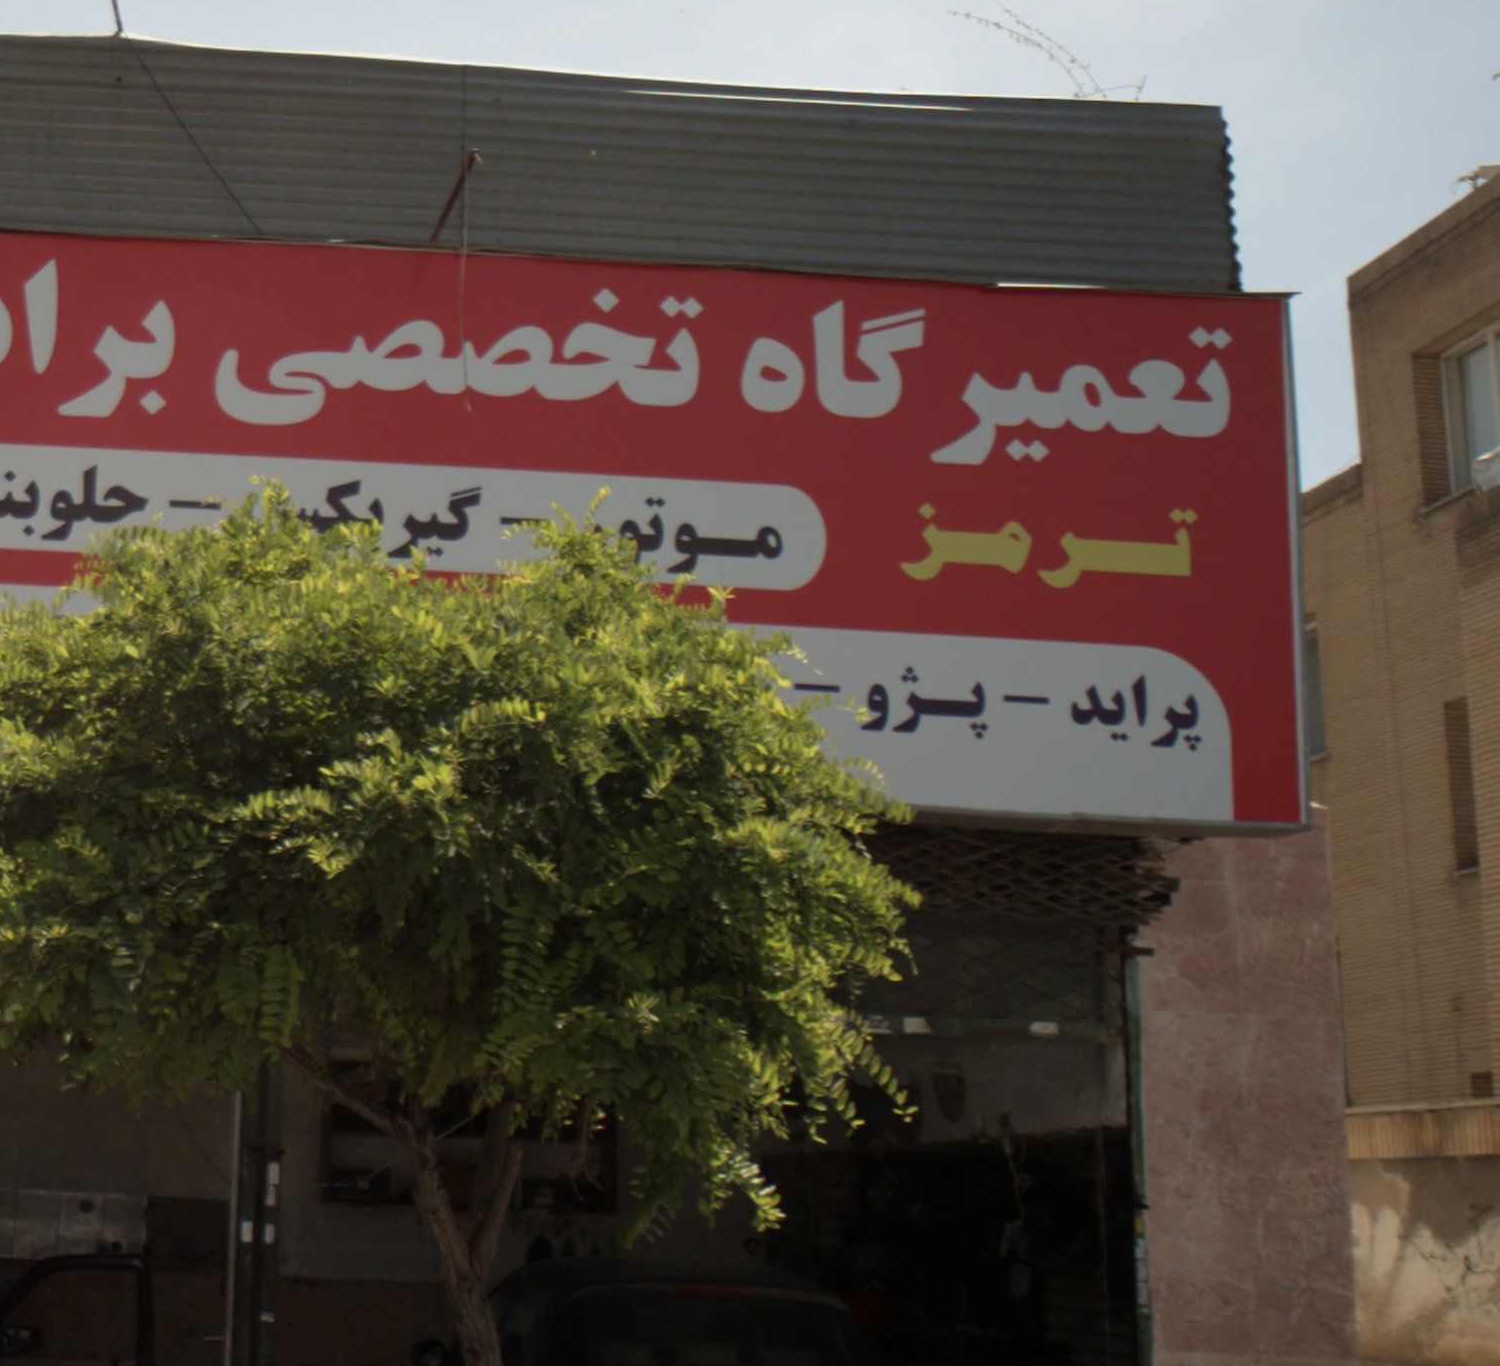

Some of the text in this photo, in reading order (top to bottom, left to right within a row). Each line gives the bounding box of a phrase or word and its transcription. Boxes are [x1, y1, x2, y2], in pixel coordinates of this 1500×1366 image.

[215, 288, 705, 426] تخصصی
[594, 497, 783, 573] موتو
[899, 501, 1200, 590] ترمز
[859, 666, 990, 740] پژو
[1071, 675, 1202, 751] پراید
